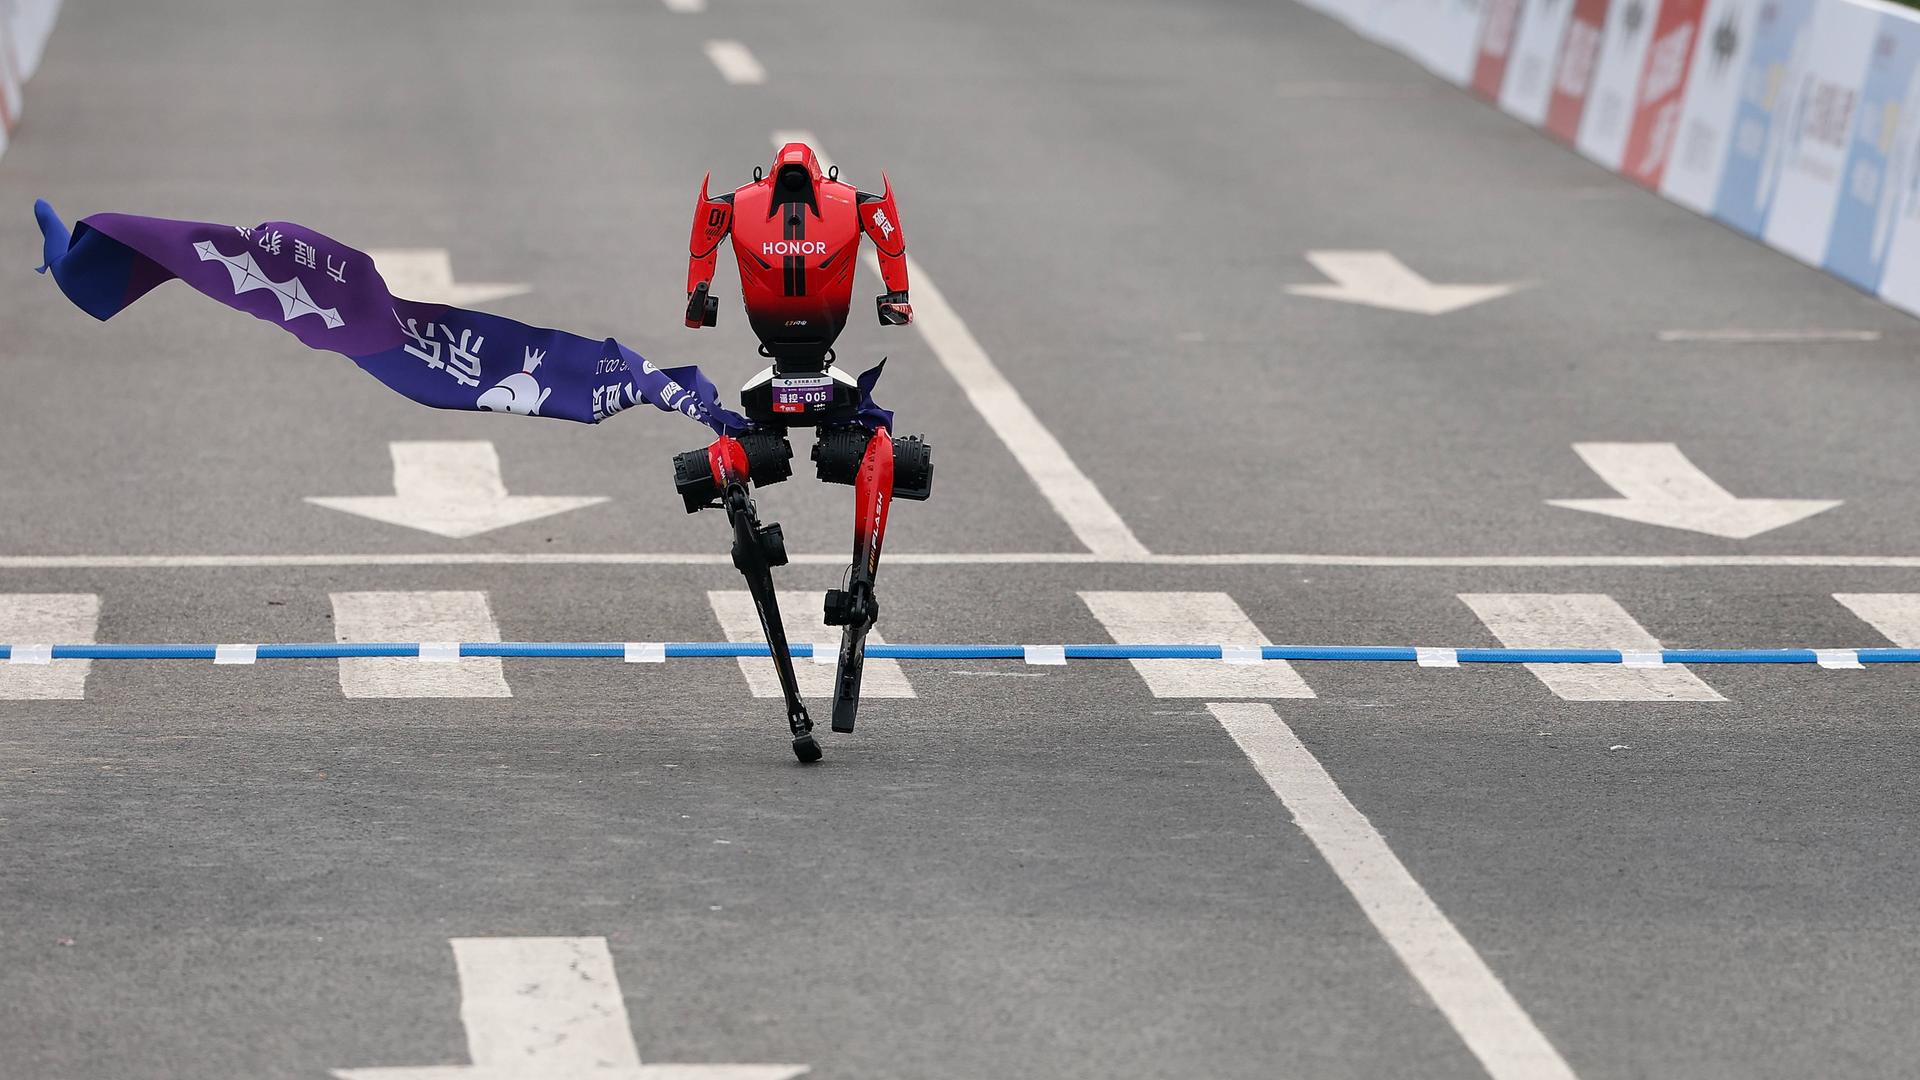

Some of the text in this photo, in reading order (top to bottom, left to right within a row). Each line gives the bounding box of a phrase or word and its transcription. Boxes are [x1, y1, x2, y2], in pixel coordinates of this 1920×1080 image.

[235, 226, 347, 284] 方程豹
[763, 241, 826, 255] HONOR
[391, 307, 484, 388] 京东
[871, 491, 885, 550] FLASH
